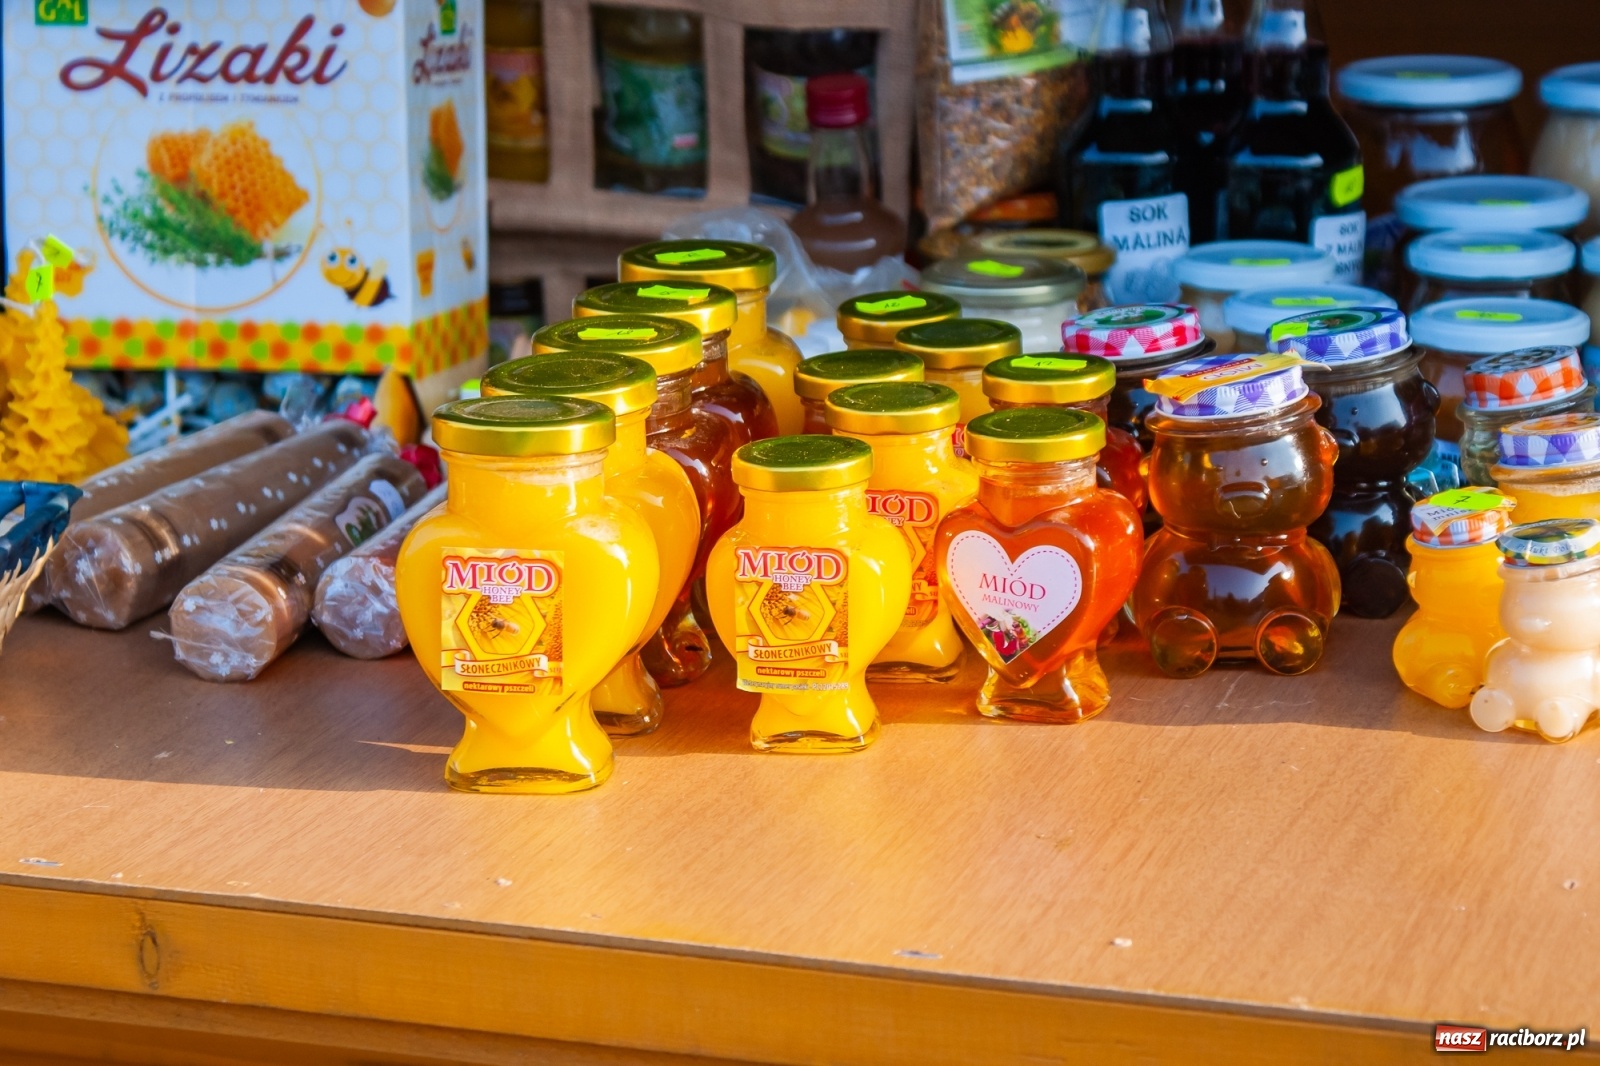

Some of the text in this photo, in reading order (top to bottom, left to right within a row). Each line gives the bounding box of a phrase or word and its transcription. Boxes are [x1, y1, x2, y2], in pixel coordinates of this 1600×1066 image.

[59, 7, 347, 98] Lizaki
[1129, 203, 1168, 223] SOK
[1112, 225, 1187, 251] MALINA
[867, 494, 933, 523] IÓD
[739, 551, 842, 581] MIÓD
[447, 562, 553, 592] MIÓD
[774, 574, 811, 584] HONEY
[979, 572, 1047, 600] MIÓD
[482, 586, 521, 596] HONEY
[782, 583, 803, 591] BEE
[491, 595, 512, 603] BEE
[982, 593, 1040, 612] MALINOWY
[754, 643, 833, 659] SŁONECZNIKOWY
[460, 657, 542, 674] SŁONECZNIKOWY
[757, 667, 826, 679] nektarowy pszczeli
[464, 683, 535, 693] nektarowy pszczeli
